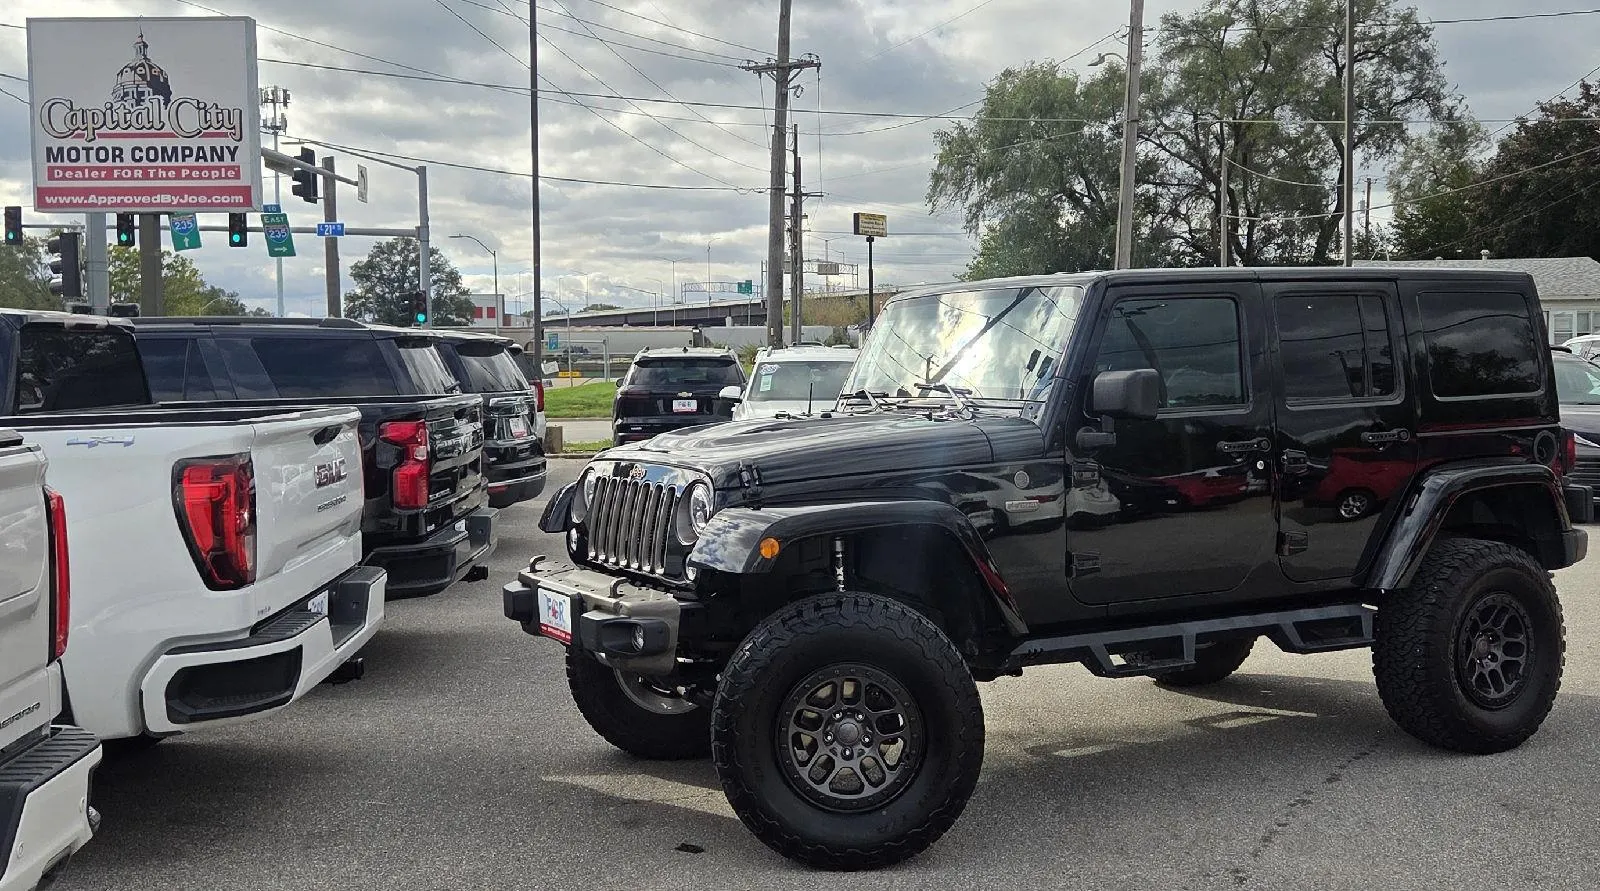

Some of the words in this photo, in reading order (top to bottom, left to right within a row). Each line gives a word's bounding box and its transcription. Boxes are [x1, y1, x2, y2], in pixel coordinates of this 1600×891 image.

[40, 97, 165, 142] Capital
[168, 97, 243, 142] City
[46, 146, 124, 163] MOTOR
[131, 146, 239, 163] COMPANY
[54, 168, 107, 179] Dealer
[113, 168, 143, 179] FOR
[147, 168, 176, 179] The
[181, 167, 236, 180] People
[45, 193, 244, 206] www.ApprovedByJoe.com
[175, 219, 194, 230] 235
[263, 215, 286, 224] EAST
[268, 227, 287, 239] 235
